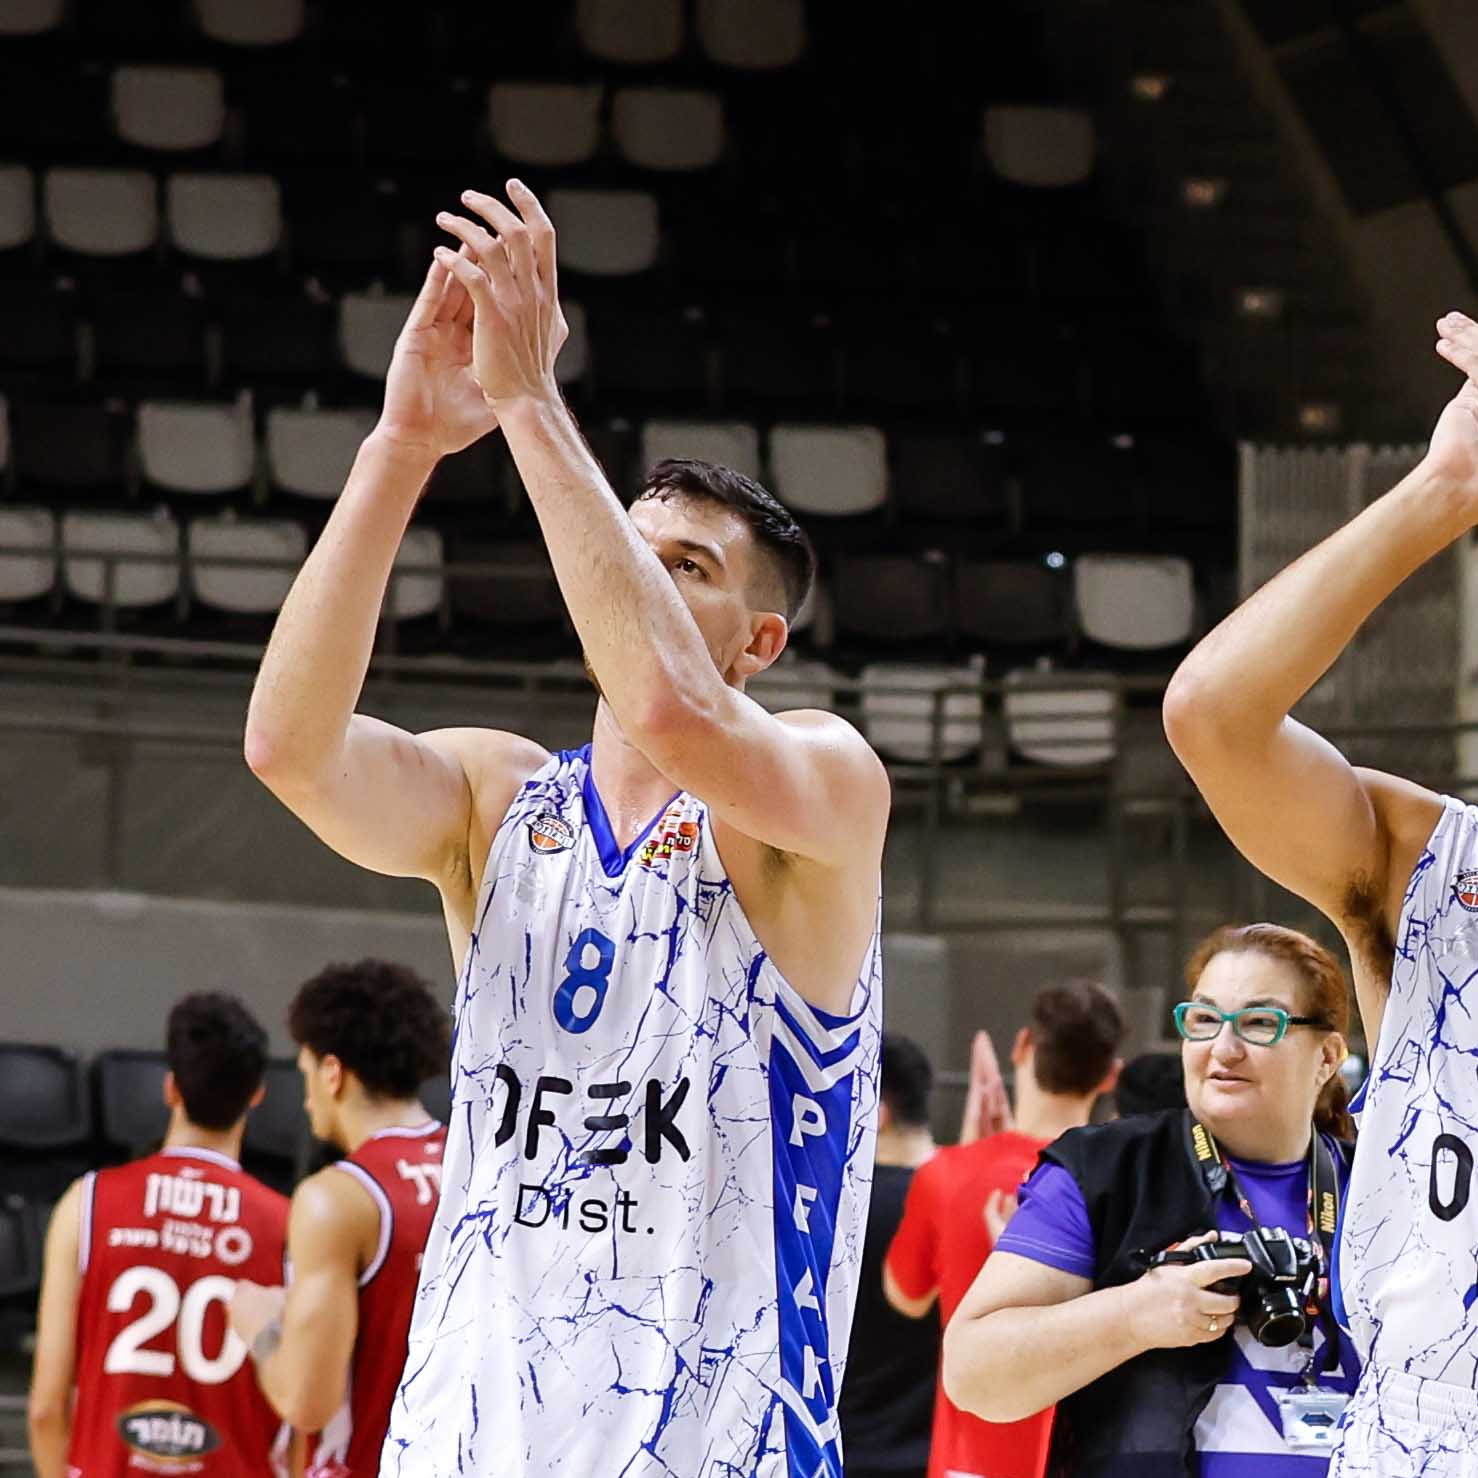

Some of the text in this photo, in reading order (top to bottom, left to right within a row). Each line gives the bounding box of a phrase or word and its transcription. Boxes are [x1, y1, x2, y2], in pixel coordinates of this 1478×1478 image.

[553, 927, 614, 1034] 8
[1192, 1124, 1212, 1161] Nikon
[514, 1183, 655, 1235] Dist.
[1320, 1192, 1336, 1233] Nikon
[104, 1265, 250, 1385] 20
